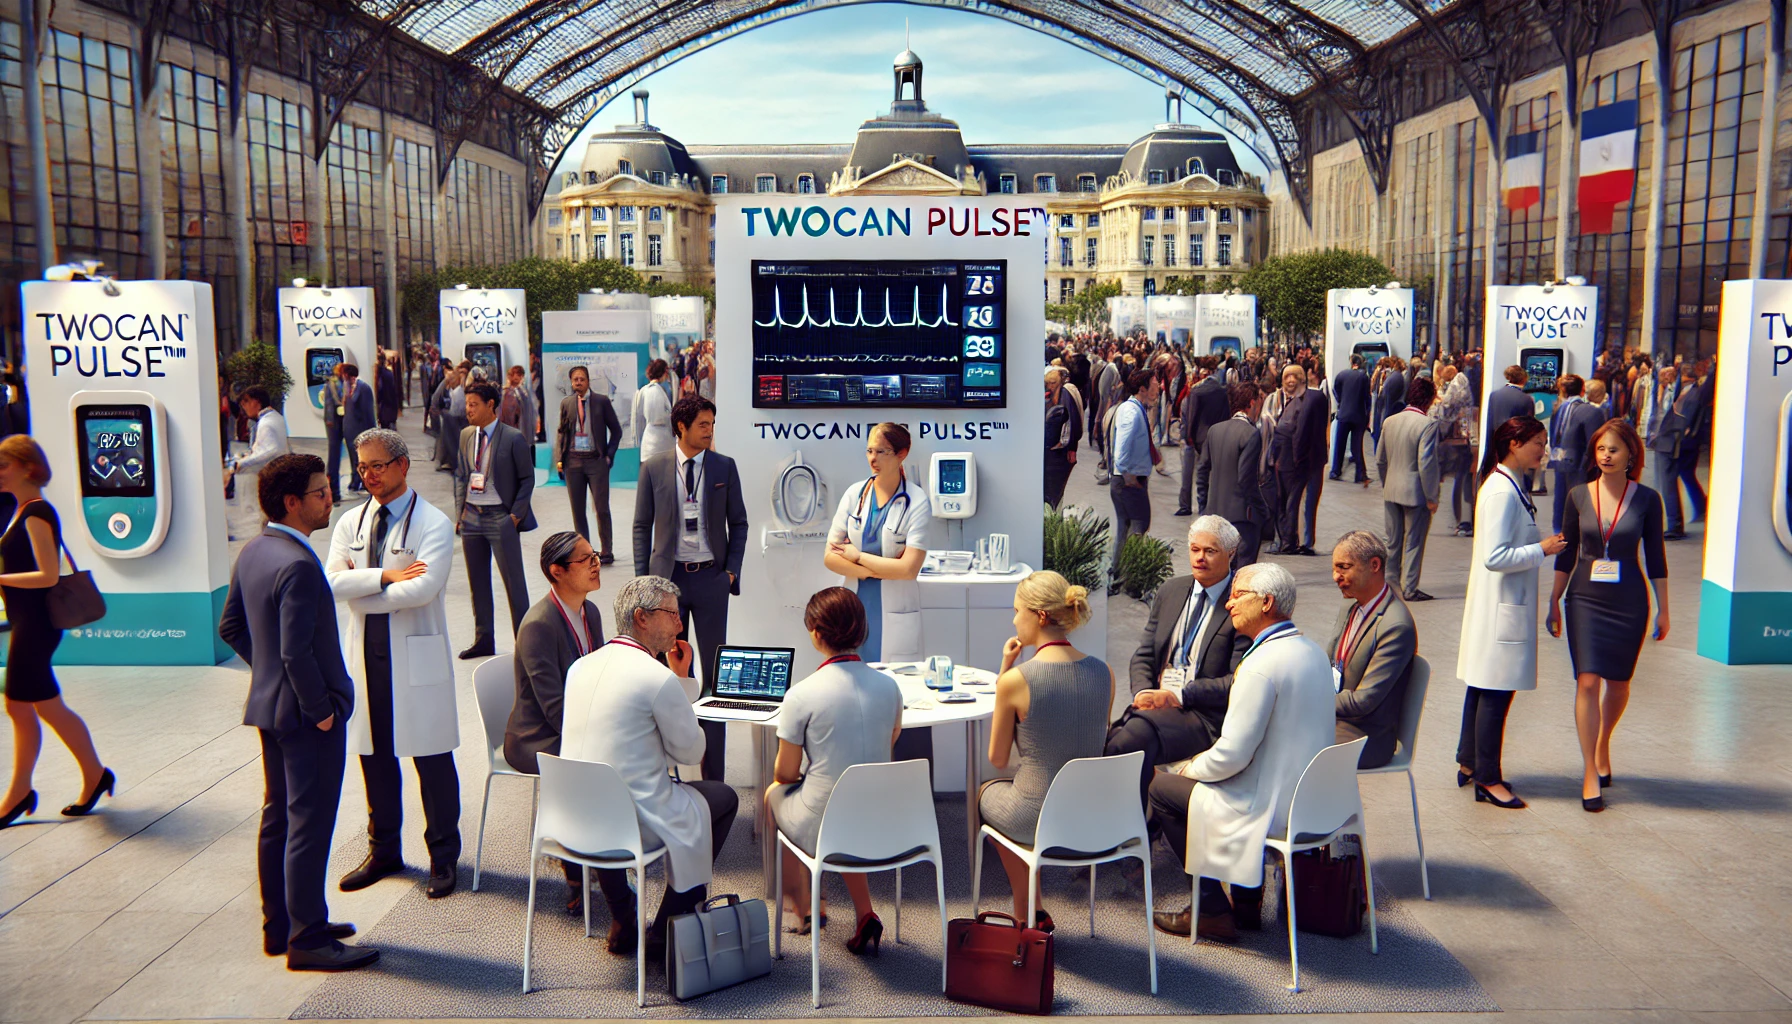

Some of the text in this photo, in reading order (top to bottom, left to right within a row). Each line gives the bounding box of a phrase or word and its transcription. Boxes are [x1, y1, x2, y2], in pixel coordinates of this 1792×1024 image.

[741, 206, 911, 237] TWOCAN
[1500, 304, 1587, 321] TWOCAN
[36, 313, 184, 342] TWOCAN
[754, 422, 861, 440] TWOCAN
